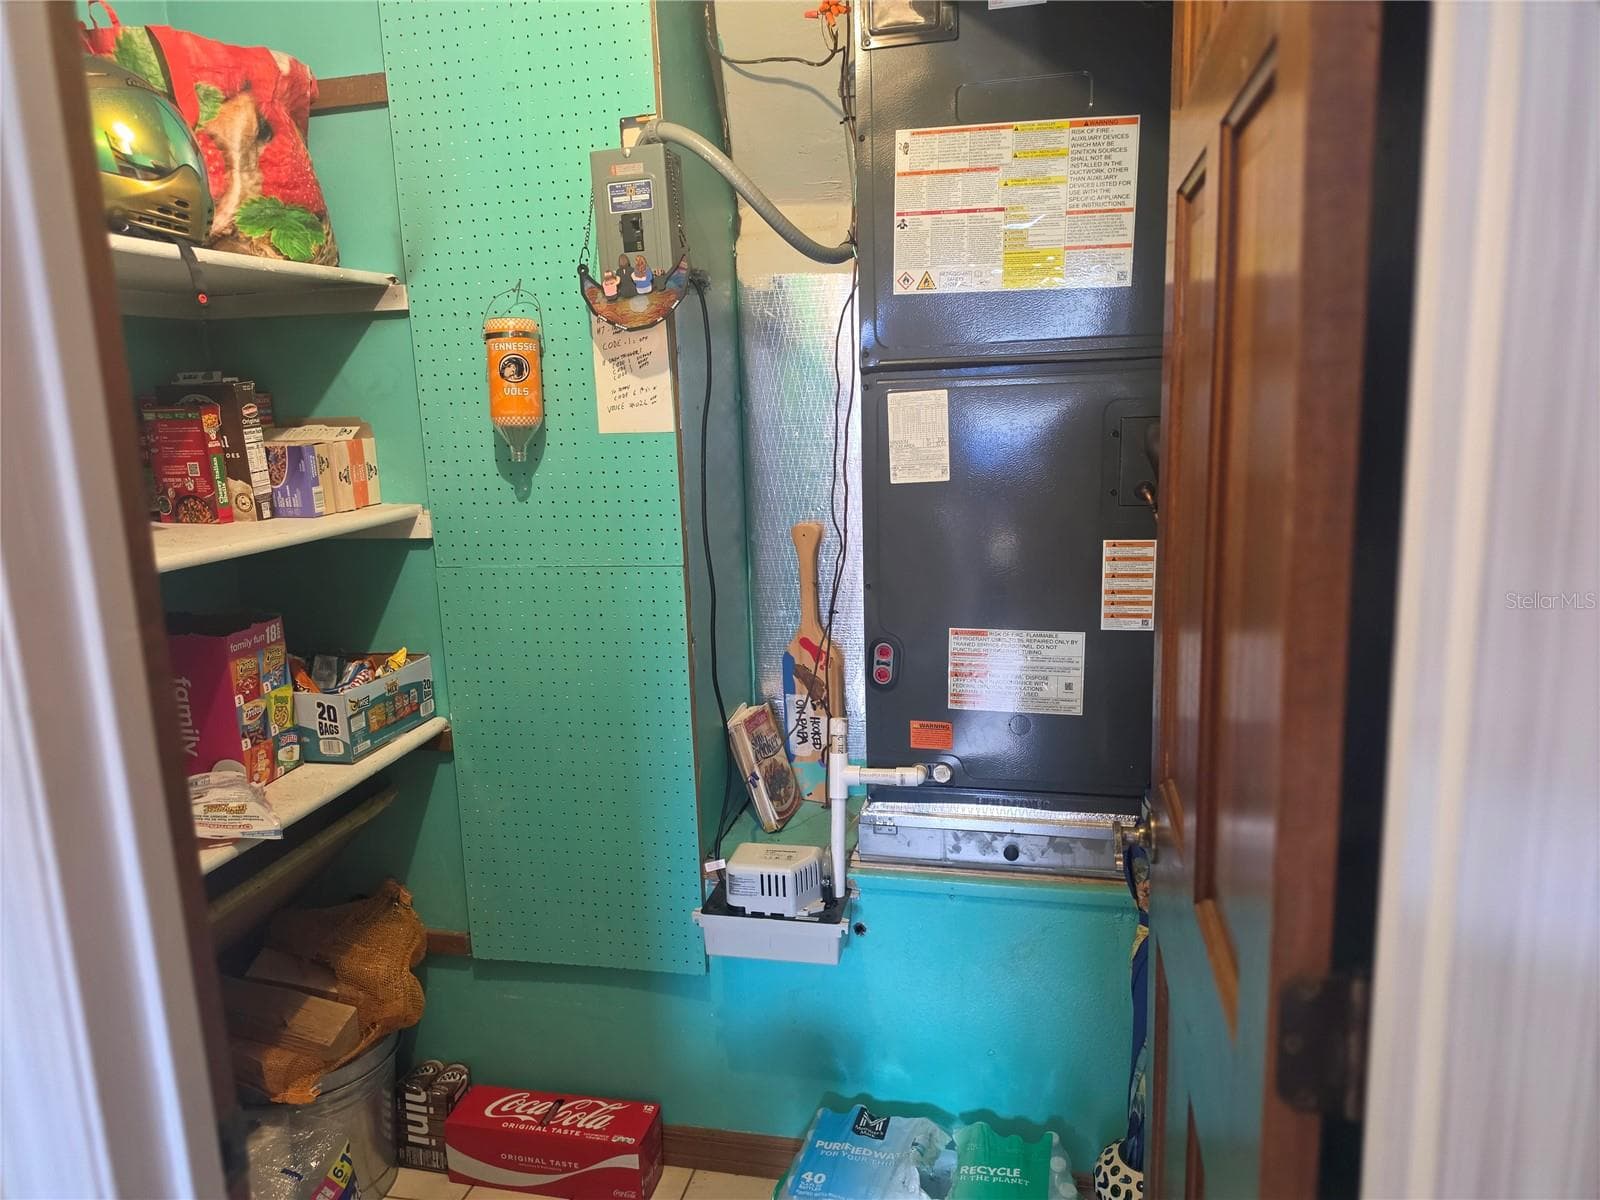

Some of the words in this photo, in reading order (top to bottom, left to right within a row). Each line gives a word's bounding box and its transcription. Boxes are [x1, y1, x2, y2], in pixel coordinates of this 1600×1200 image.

[491, 342, 537, 351] TENNESSEE
[503, 387, 529, 396] VOLS
[230, 640, 253, 653] family
[265, 624, 277, 644] 18
[422, 679, 431, 690] 20
[316, 702, 338, 724] 20
[318, 721, 339, 736] BAGS
[809, 716, 822, 750] HOOKED
[643, 1104, 655, 1112] 12
[501, 1121, 548, 1133] ORIGINAL
[551, 1127, 583, 1137] TASTE
[815, 1140, 873, 1157] PURIFIED
[500, 1152, 546, 1166] ORIGINAL
[549, 1158, 579, 1169] TASTE
[801, 1171, 826, 1184] 40
[960, 1165, 1021, 1178] RECYCLE
[970, 1174, 990, 1182] THE
[992, 1176, 1030, 1186] PLANET
